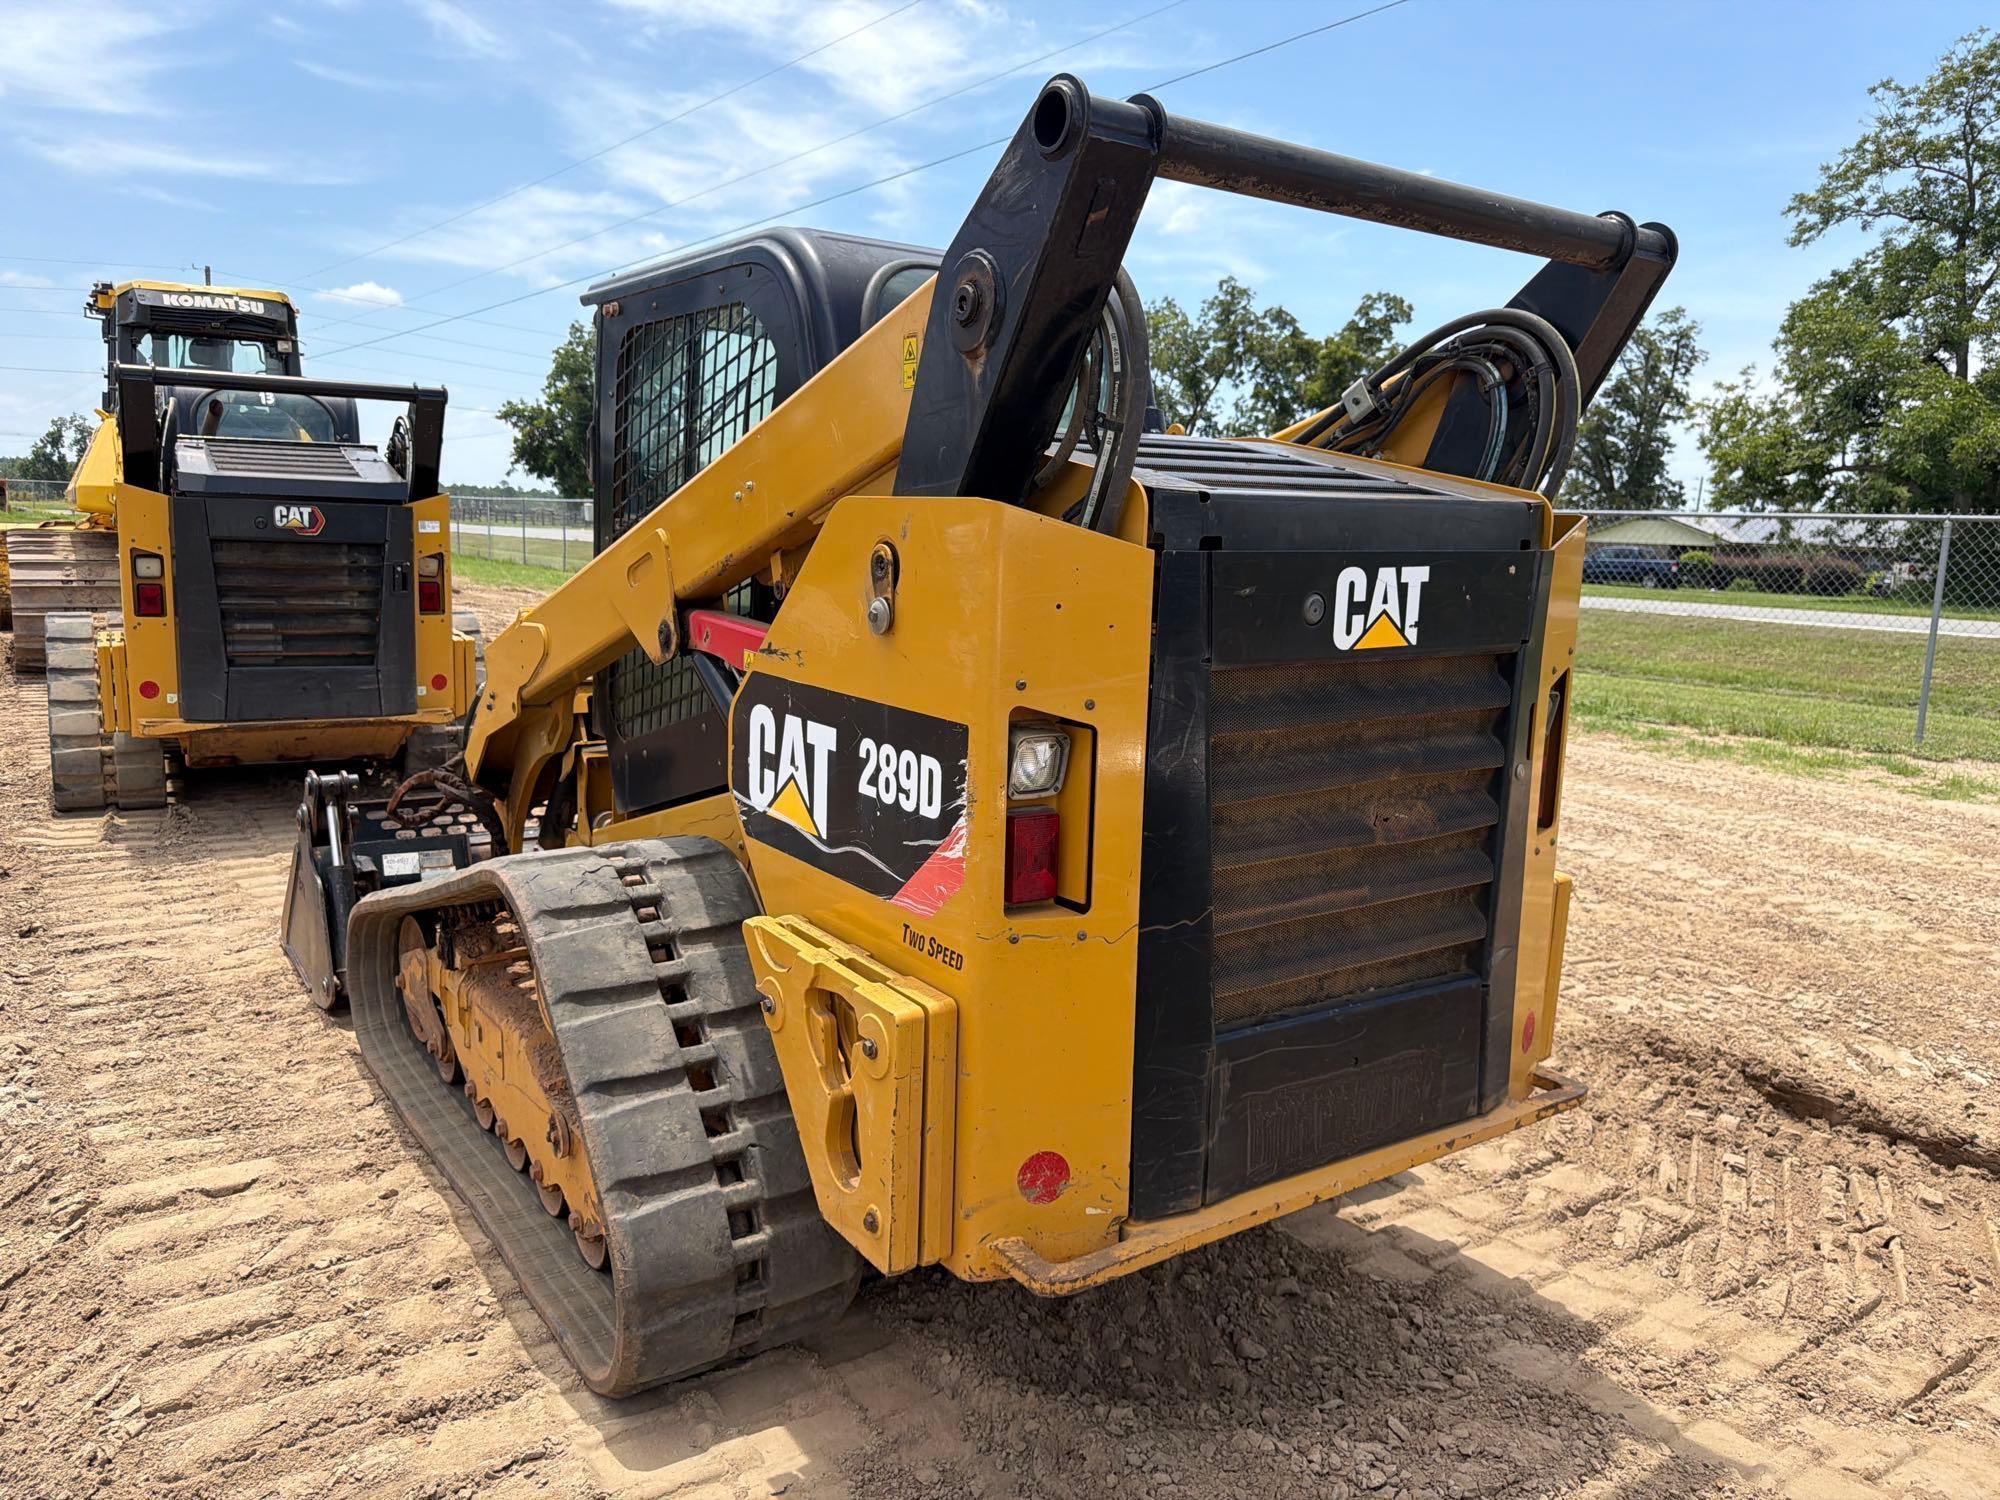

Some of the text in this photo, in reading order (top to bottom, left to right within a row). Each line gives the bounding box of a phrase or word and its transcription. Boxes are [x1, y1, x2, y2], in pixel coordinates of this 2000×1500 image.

[162, 293, 265, 314] KOMATSU
[259, 391, 275, 406] 13
[274, 505, 312, 529] CAT
[1333, 566, 1430, 651] CAT
[748, 703, 943, 840] CAT 289D
